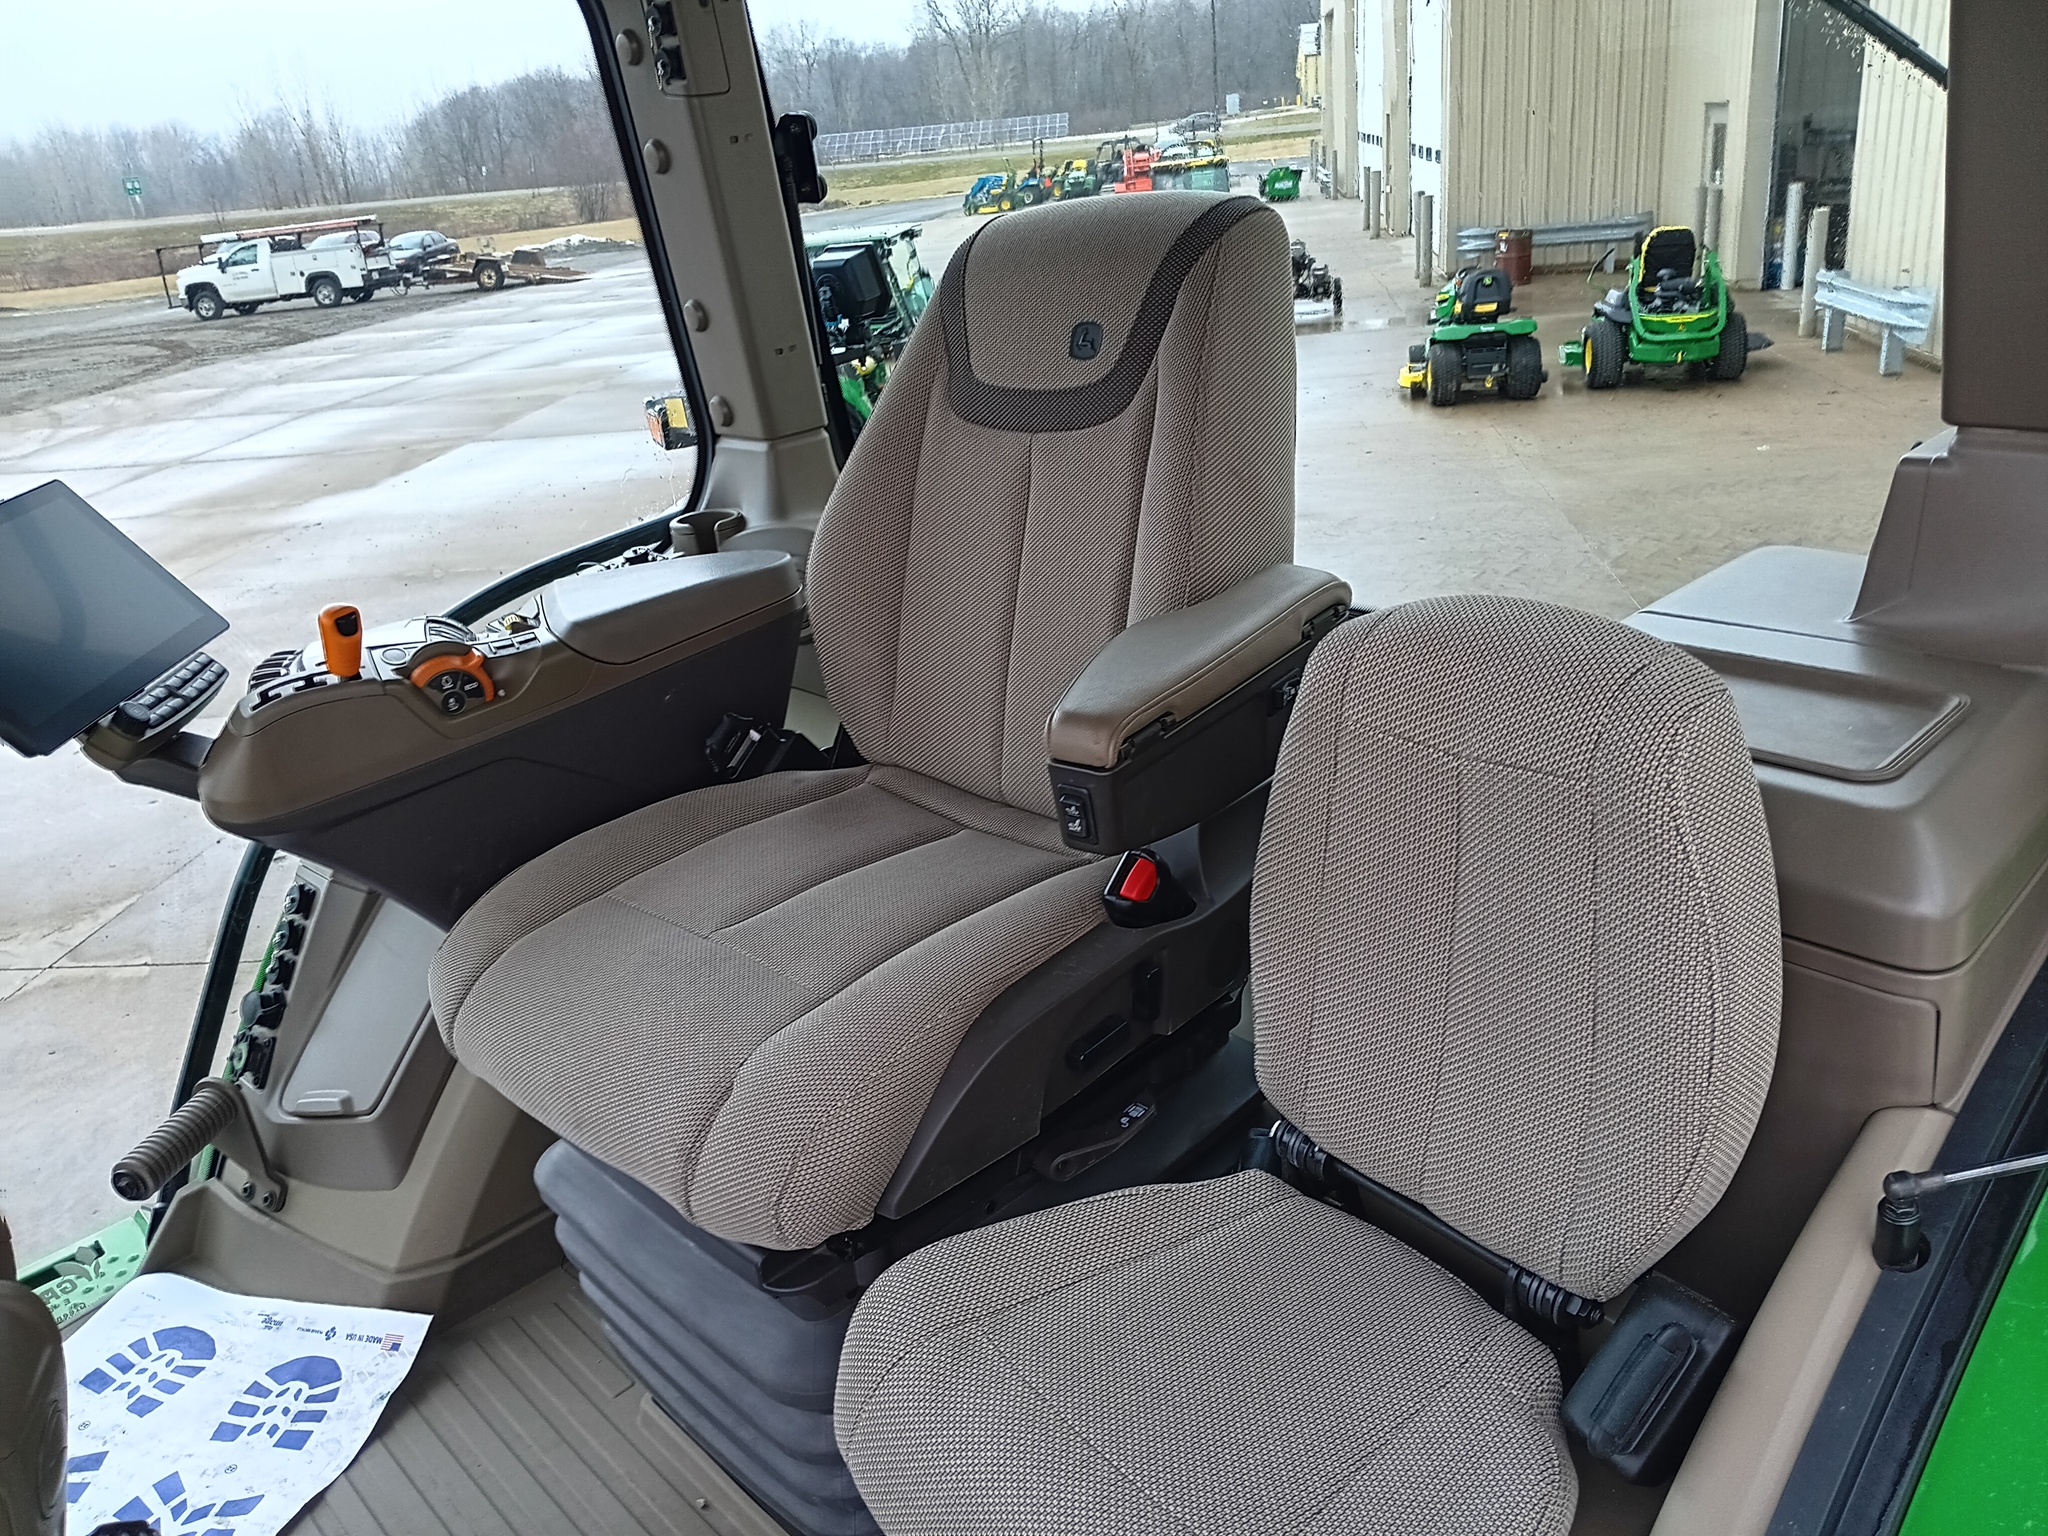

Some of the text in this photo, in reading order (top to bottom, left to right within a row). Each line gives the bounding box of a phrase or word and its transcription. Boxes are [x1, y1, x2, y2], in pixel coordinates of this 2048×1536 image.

[345, 1332, 384, 1345] MADE IN USA
